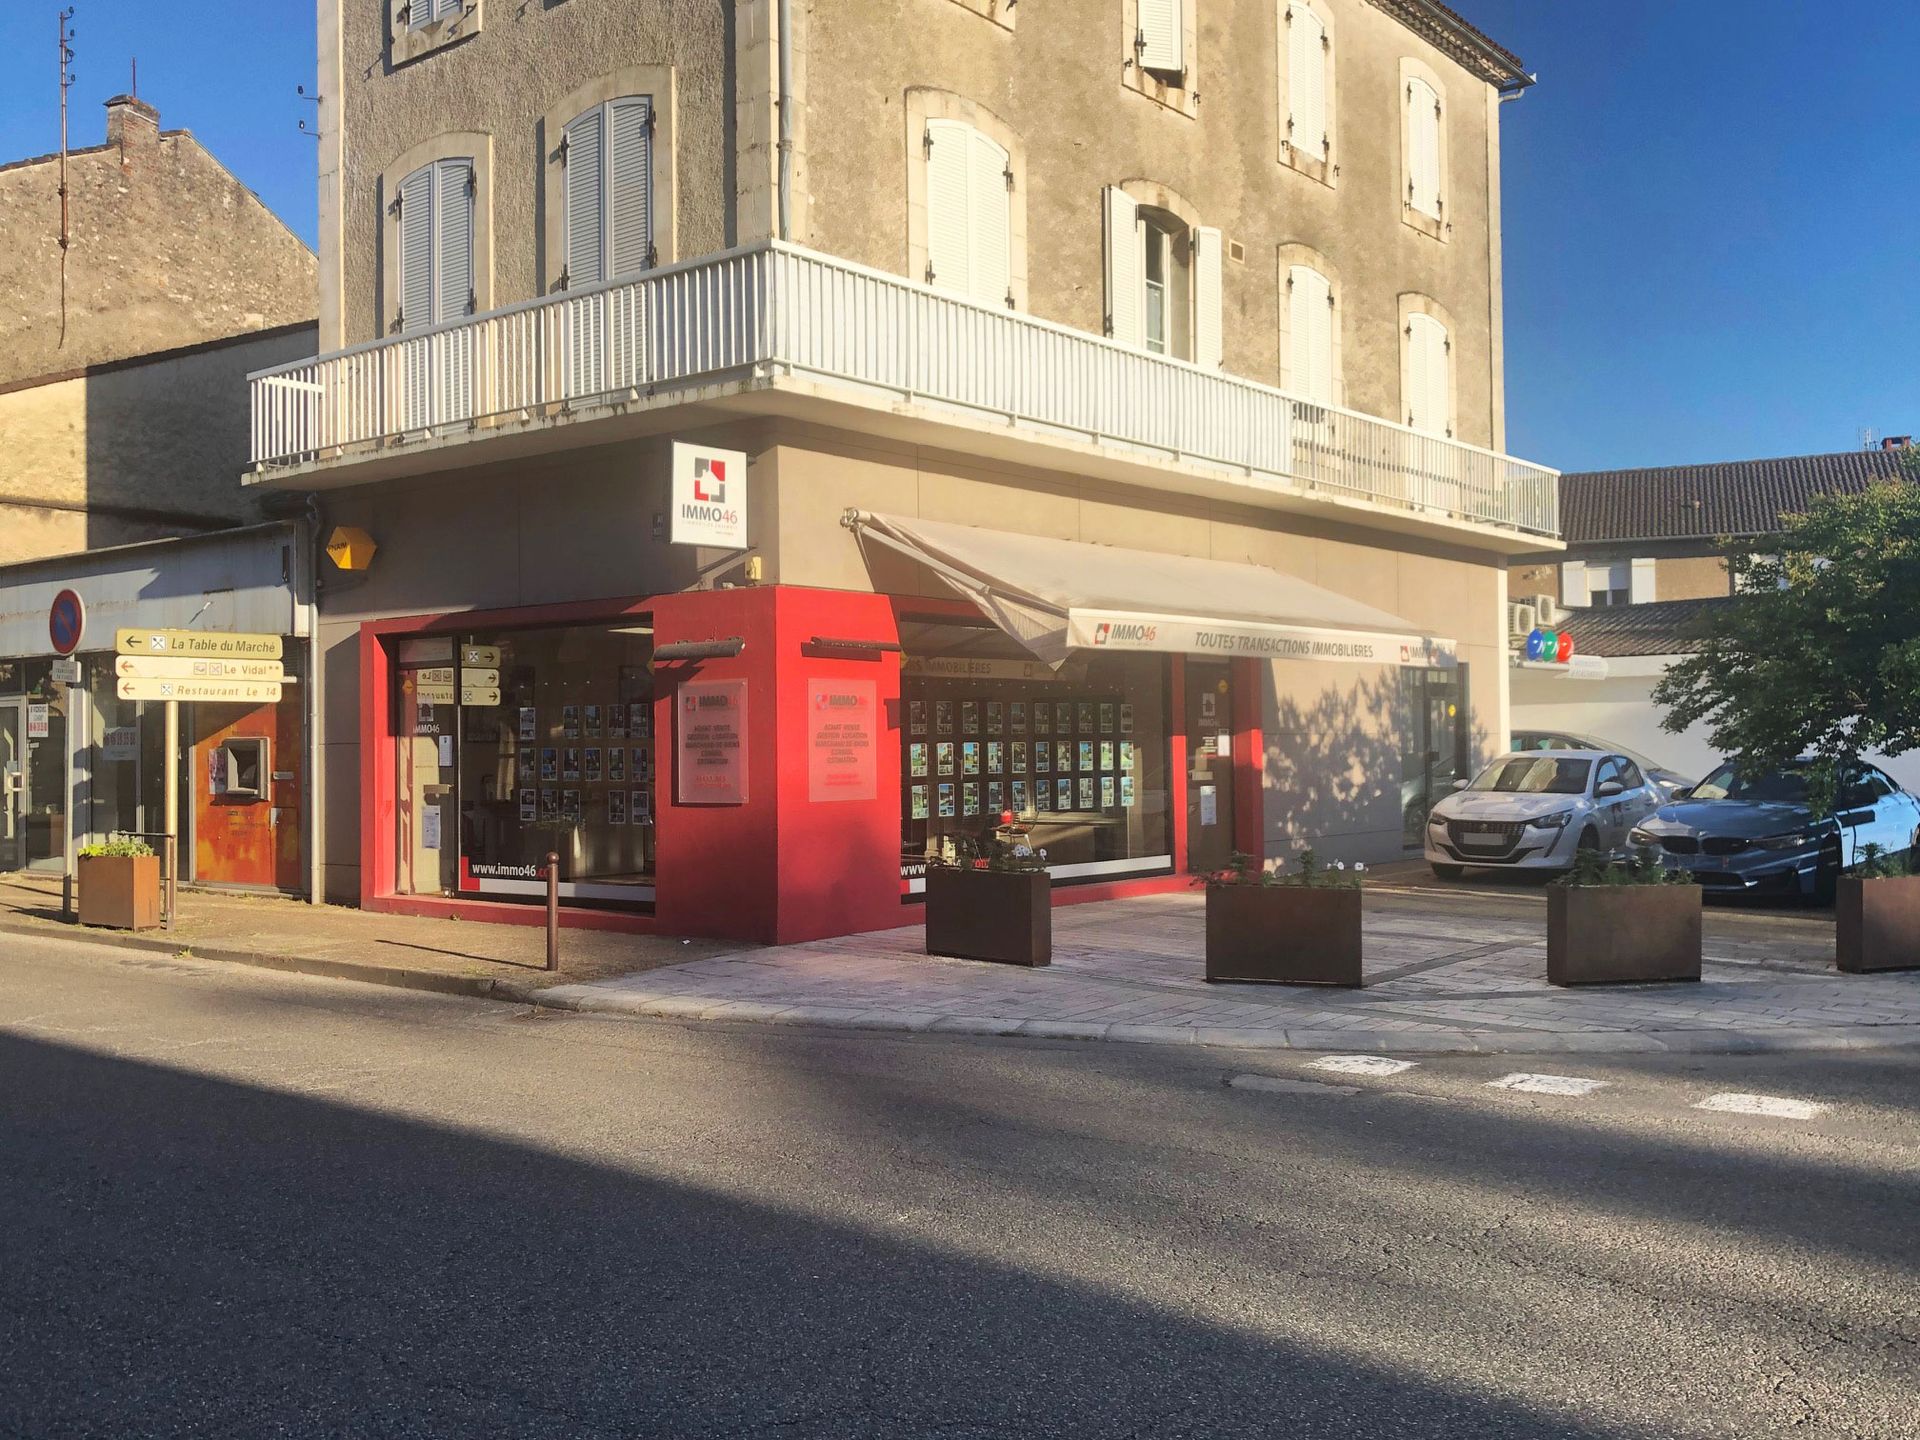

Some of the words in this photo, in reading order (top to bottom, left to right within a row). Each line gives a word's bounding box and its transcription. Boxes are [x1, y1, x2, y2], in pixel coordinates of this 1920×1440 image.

[682, 504, 738, 525] IMMO46
[1111, 624, 1157, 641] IMMO46
[171, 638, 184, 650] La
[188, 638, 217, 651] Table
[220, 640, 233, 651] du
[235, 641, 275, 653] Marché
[1195, 632, 1234, 649] TOUTES
[1237, 635, 1310, 655] TRANSACTIONS
[224, 665, 236, 675] Le
[177, 686, 239, 696] Restaurant
[246, 687, 258, 697] Le
[265, 687, 277, 697] 14
